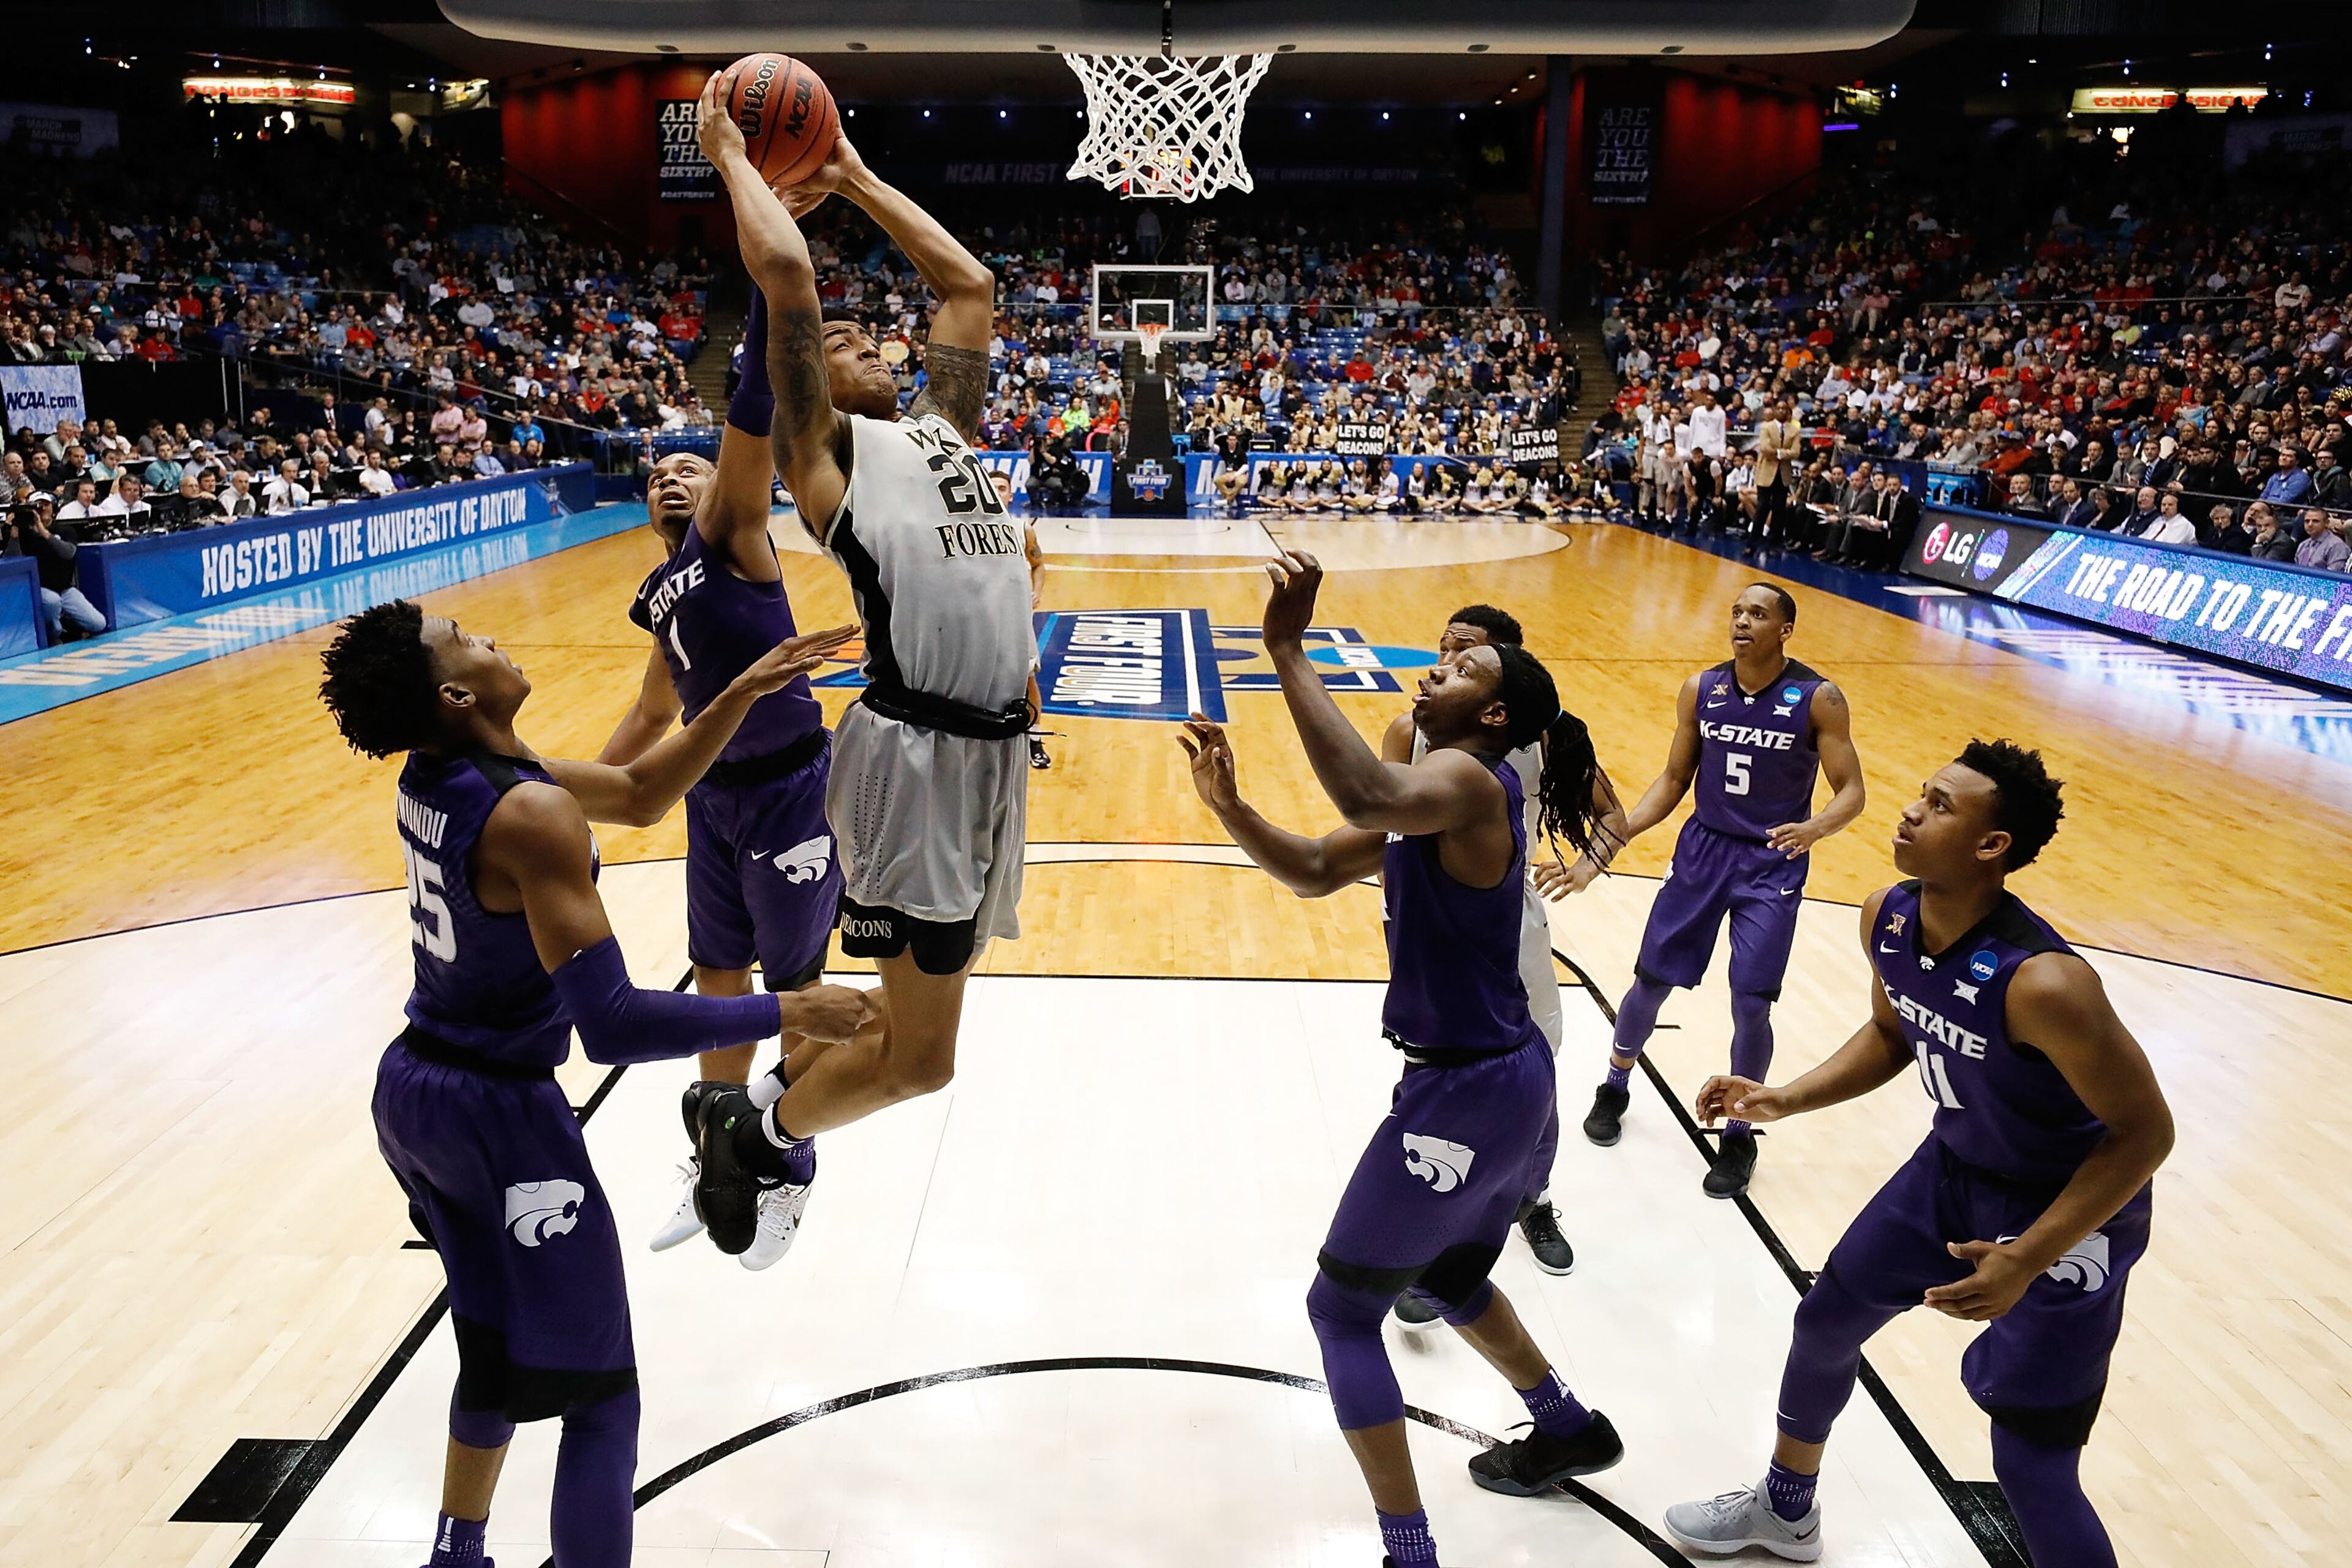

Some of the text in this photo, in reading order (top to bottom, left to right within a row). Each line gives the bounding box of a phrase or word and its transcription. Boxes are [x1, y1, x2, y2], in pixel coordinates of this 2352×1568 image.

[186, 85, 355, 103] CONCESSIONS
[740, 58, 781, 137] Wilson
[2094, 96, 2263, 108] CONCESIONS
[659, 102, 698, 123] AR
[785, 77, 813, 140] NCAA
[1598, 107, 1651, 126] ARE
[1600, 128, 1651, 146] YOU
[1598, 149, 1649, 167] THE
[659, 165, 715, 178] SIXTH?
[945, 163, 997, 183] NCAA
[1002, 163, 1060, 183] FIRST
[6, 391, 78, 410] NCAA.com
[1338, 424, 1384, 439] LET'S GO
[1511, 428, 1558, 446] LET'S GO
[1336, 440, 1384, 455] DEACONS
[1512, 445, 1559, 462] DEACONS
[926, 453, 1005, 517] 20
[202, 532, 292, 598] HOSTED
[298, 527, 325, 575] BY
[328, 518, 363, 567] THE
[367, 500, 459, 558] UNIVERSITY
[461, 497, 478, 535] OF
[480, 488, 527, 532] DAYTON
[1942, 530, 1975, 565] LG
[649, 557, 706, 633] STATE
[2065, 553, 2352, 663] THE ROAD TO THE FI
[669, 614, 691, 672] 1
[1050, 615, 1163, 705] FIRST FOUR
[1700, 719, 1796, 750] K-STATE
[1725, 752, 1752, 796] 5
[397, 788, 448, 849] WUNDU
[841, 911, 892, 938] DEACONS
[1972, 962, 1995, 977] NCAA
[1915, 1040, 1966, 1110] 11
